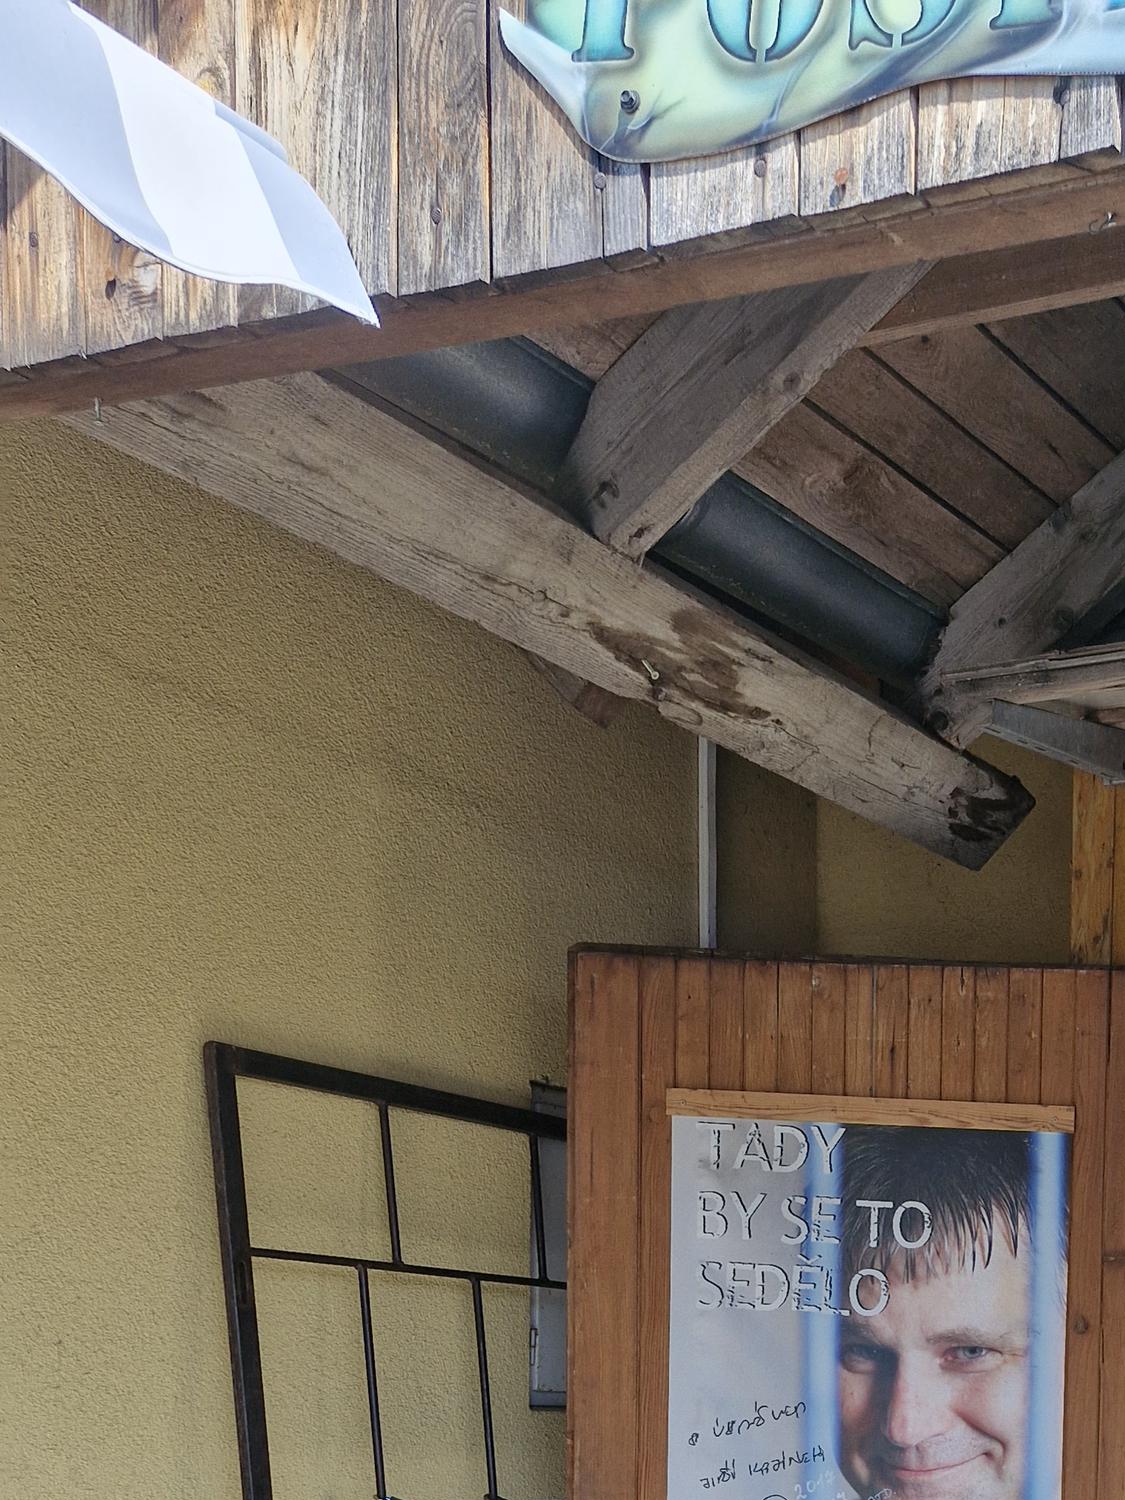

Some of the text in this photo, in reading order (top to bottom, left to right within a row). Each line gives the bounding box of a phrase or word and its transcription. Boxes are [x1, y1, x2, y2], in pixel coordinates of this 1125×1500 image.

[697, 1122, 847, 1174] TADY
[698, 1190, 933, 1249] BY SE TO
[697, 1254, 890, 1318] SEDĚLO
